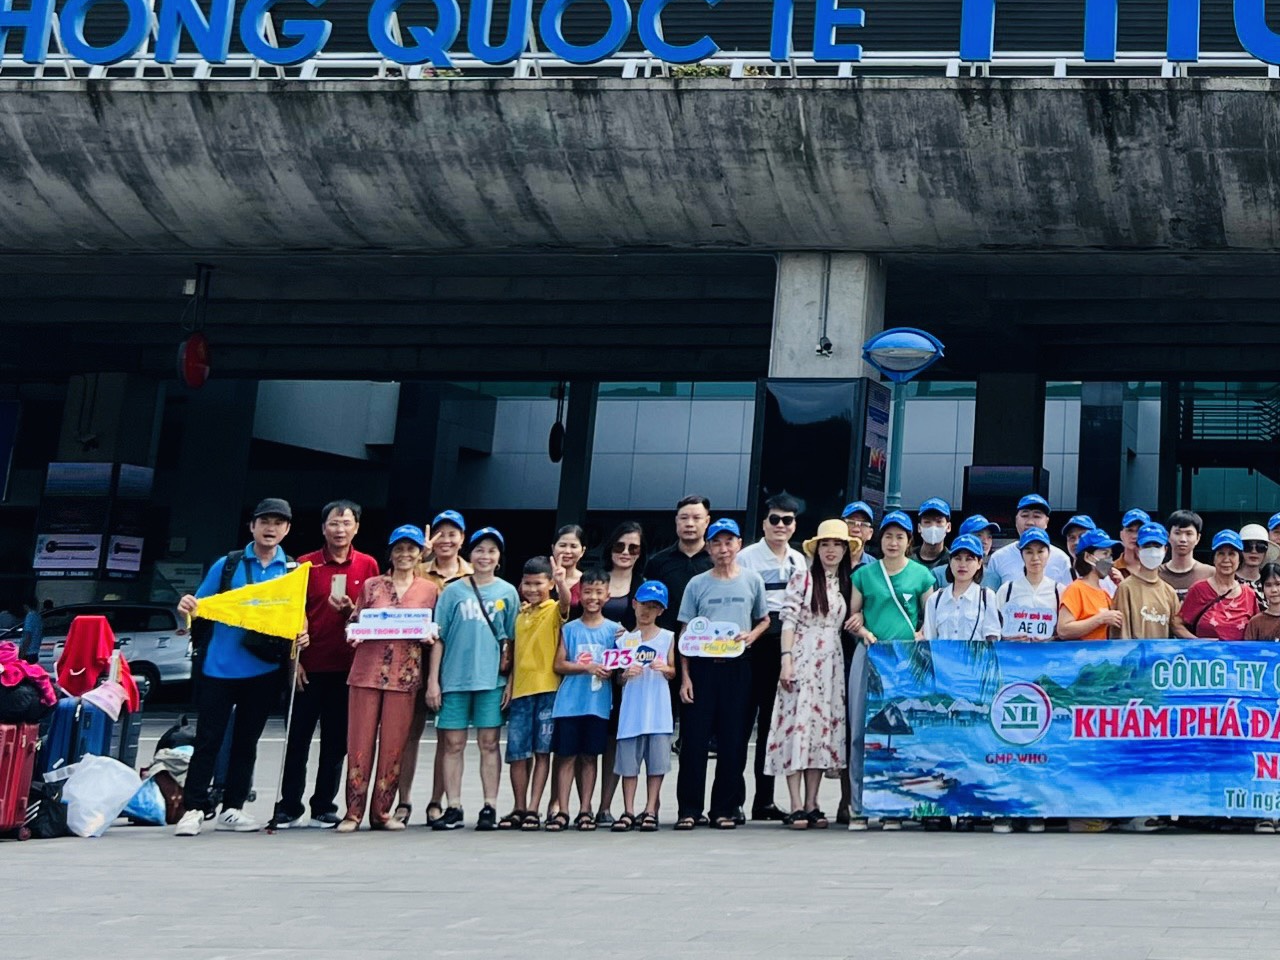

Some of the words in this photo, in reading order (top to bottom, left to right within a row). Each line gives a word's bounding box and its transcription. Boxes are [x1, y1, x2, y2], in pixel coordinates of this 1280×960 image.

[1018, 621, 1033, 634] AE
[603, 649, 632, 667] 123
[1154, 656, 1225, 688] CÔNG
[1236, 662, 1265, 689] TY
[1002, 705, 1038, 722] NH
[1073, 700, 1170, 738] KHÁM
[1179, 700, 1241, 737] PHÁ
[985, 752, 1048, 764] GMP-WHO
